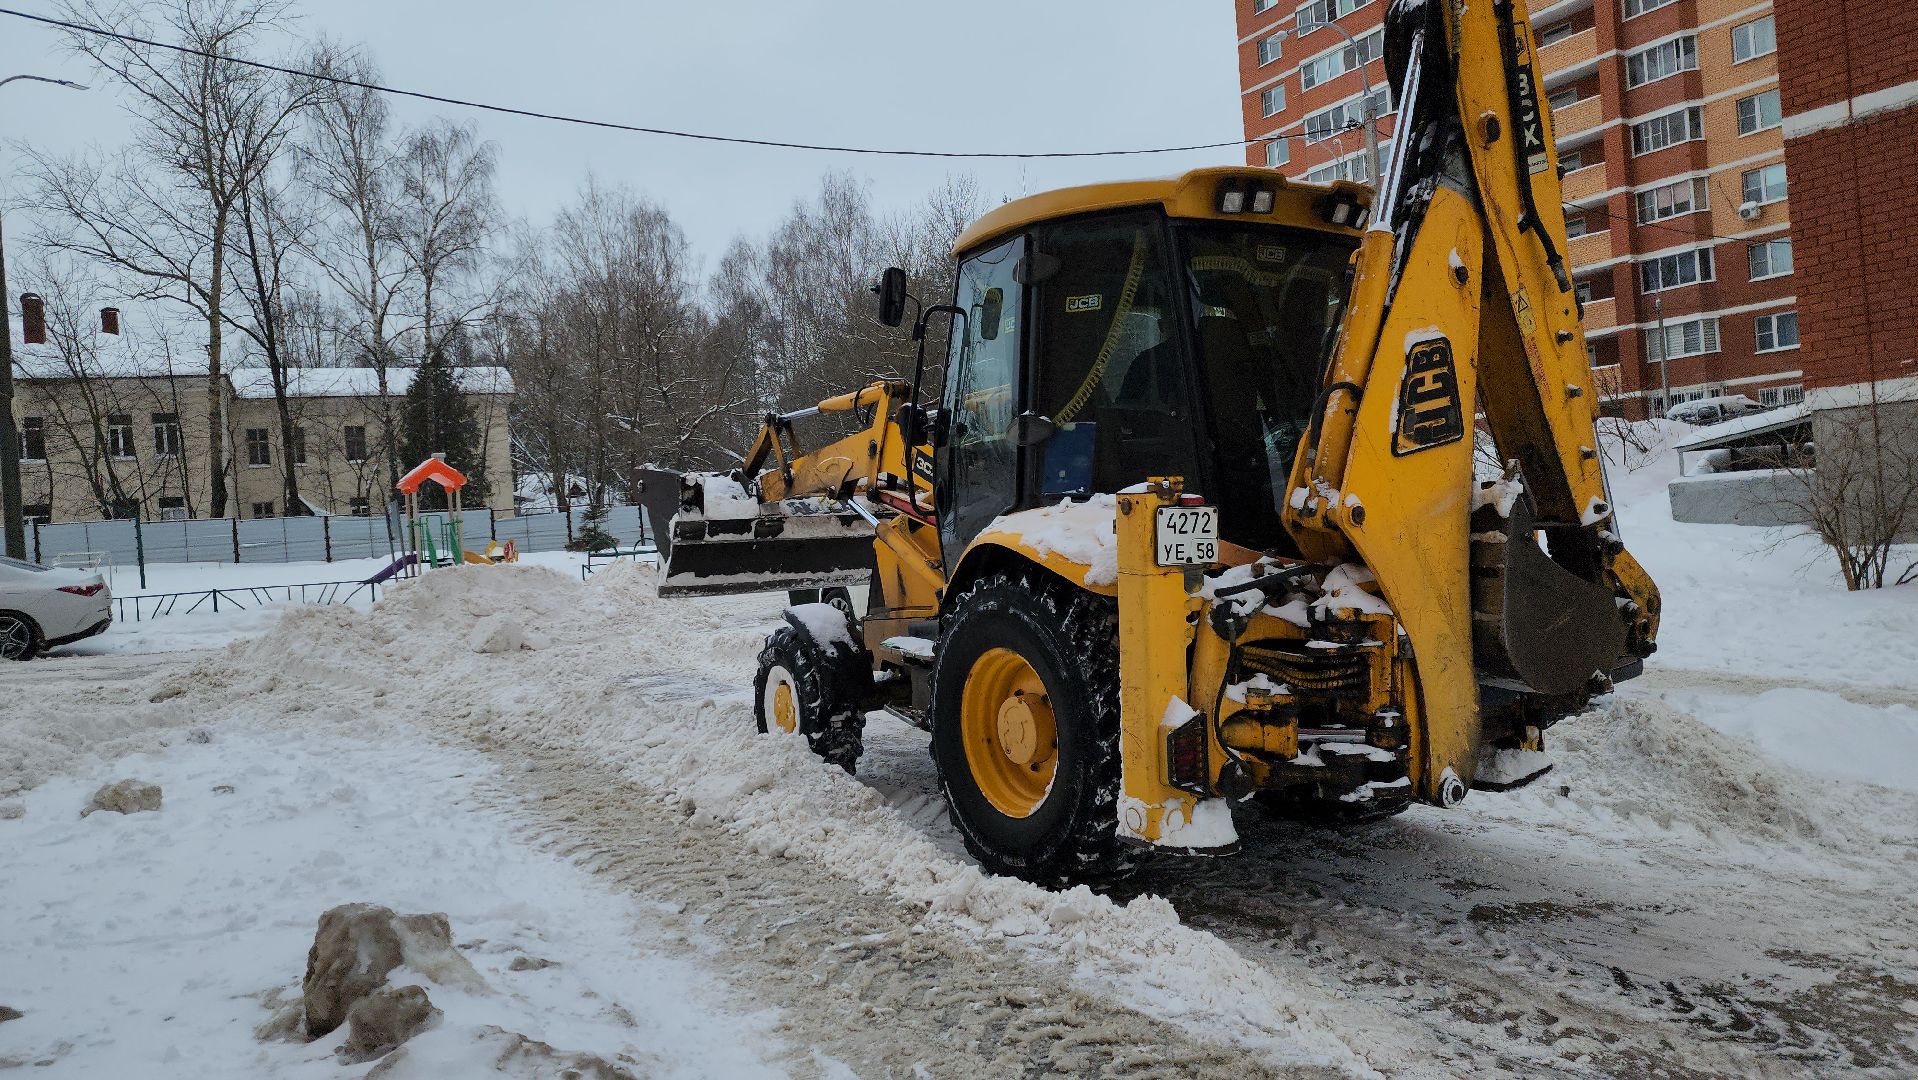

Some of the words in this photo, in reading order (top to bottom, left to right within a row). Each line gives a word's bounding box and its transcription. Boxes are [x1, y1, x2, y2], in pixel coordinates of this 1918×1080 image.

[1069, 296, 1099, 309] JCB
[1402, 345, 1463, 446] JCB
[916, 457, 934, 477] 3C
[1166, 511, 1211, 534] 4272
[1196, 542, 1214, 560] 58
